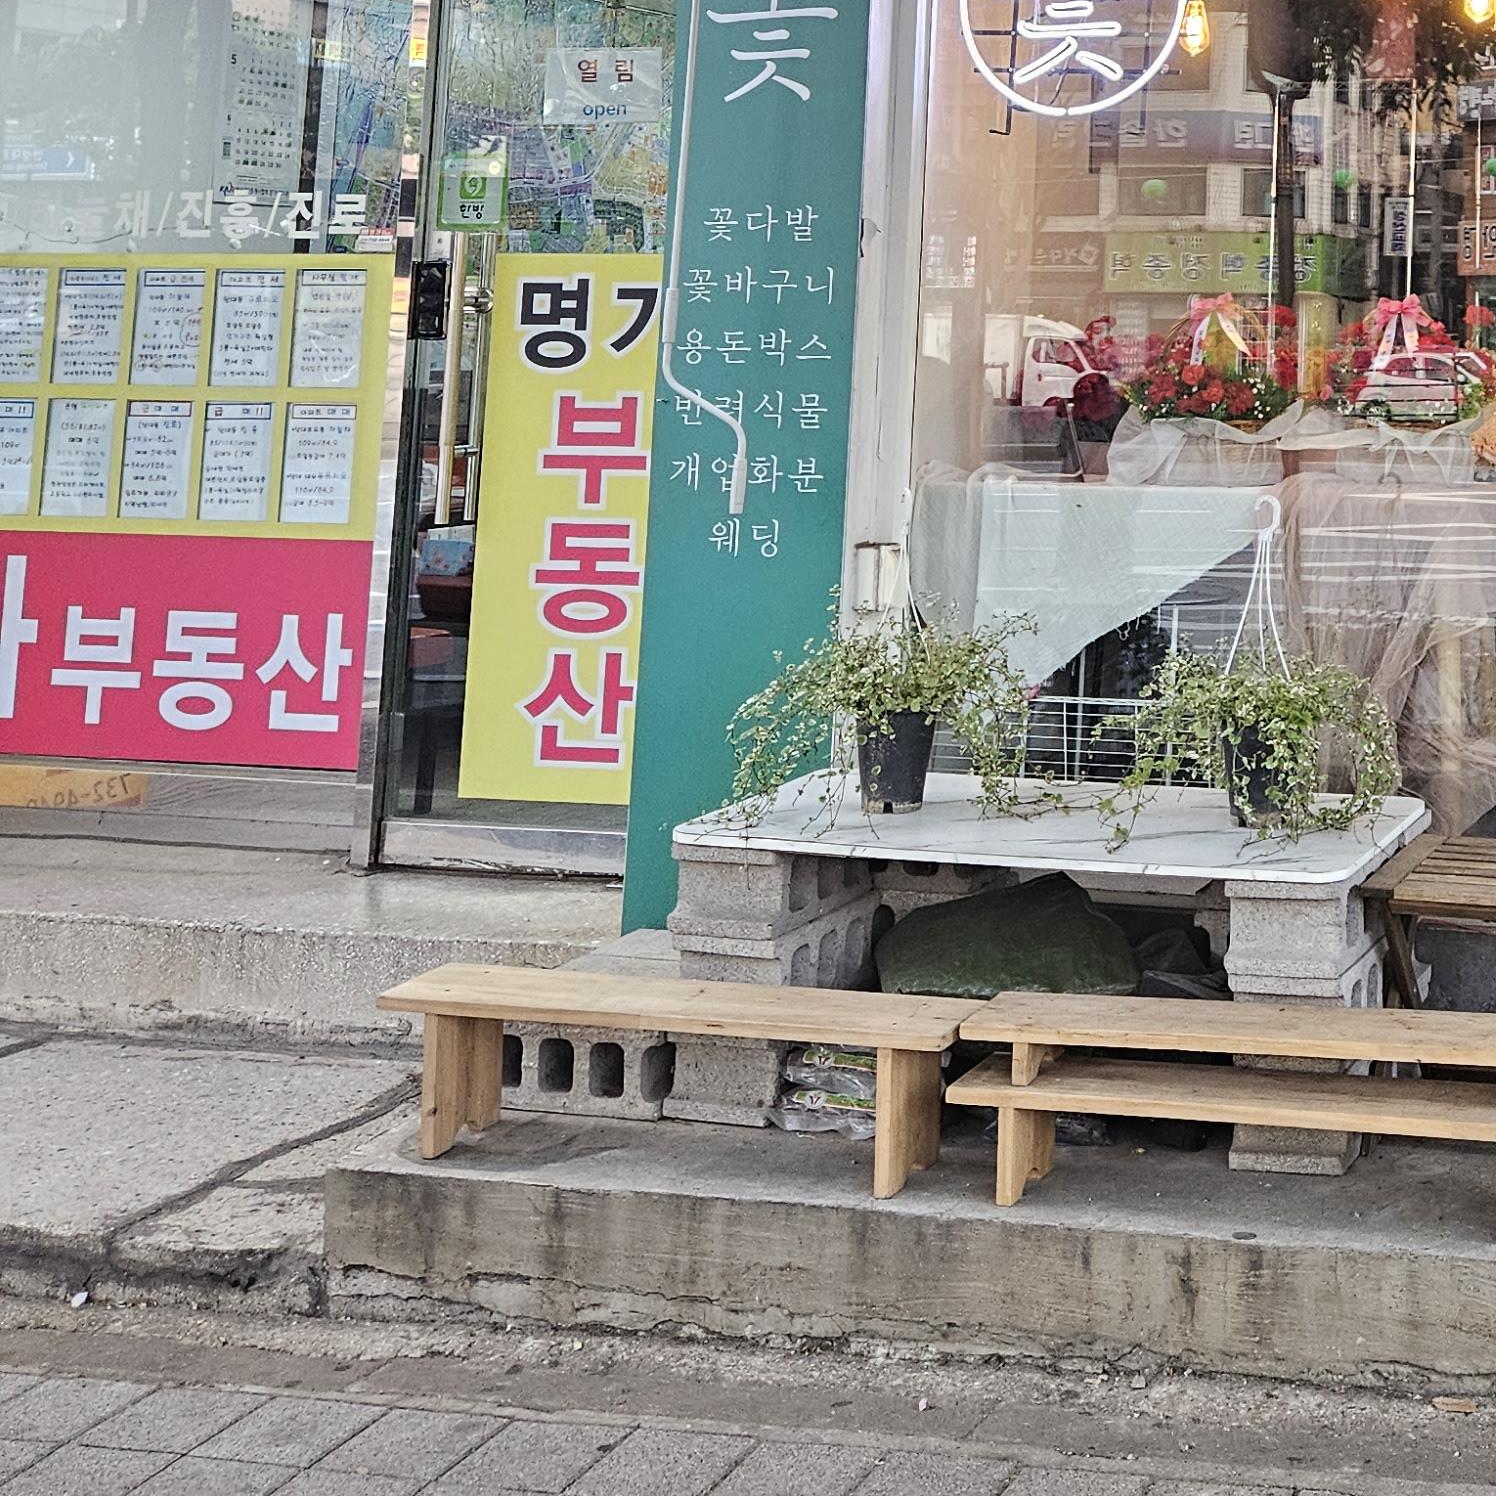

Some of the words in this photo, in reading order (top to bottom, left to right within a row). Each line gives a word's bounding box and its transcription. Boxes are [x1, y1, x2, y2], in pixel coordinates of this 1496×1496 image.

[583, 102, 627, 120] open
[703, 204, 820, 243] 꽃다발
[682, 265, 834, 305] 꽃바구니
[676, 327, 832, 367] 용돈박스
[674, 388, 829, 430] 반려식물
[669, 451, 825, 494] 개업화분
[708, 517, 780, 558] 웨딩
[522, 395, 648, 763] 부동산
[50, 606, 354, 733] 부동산
